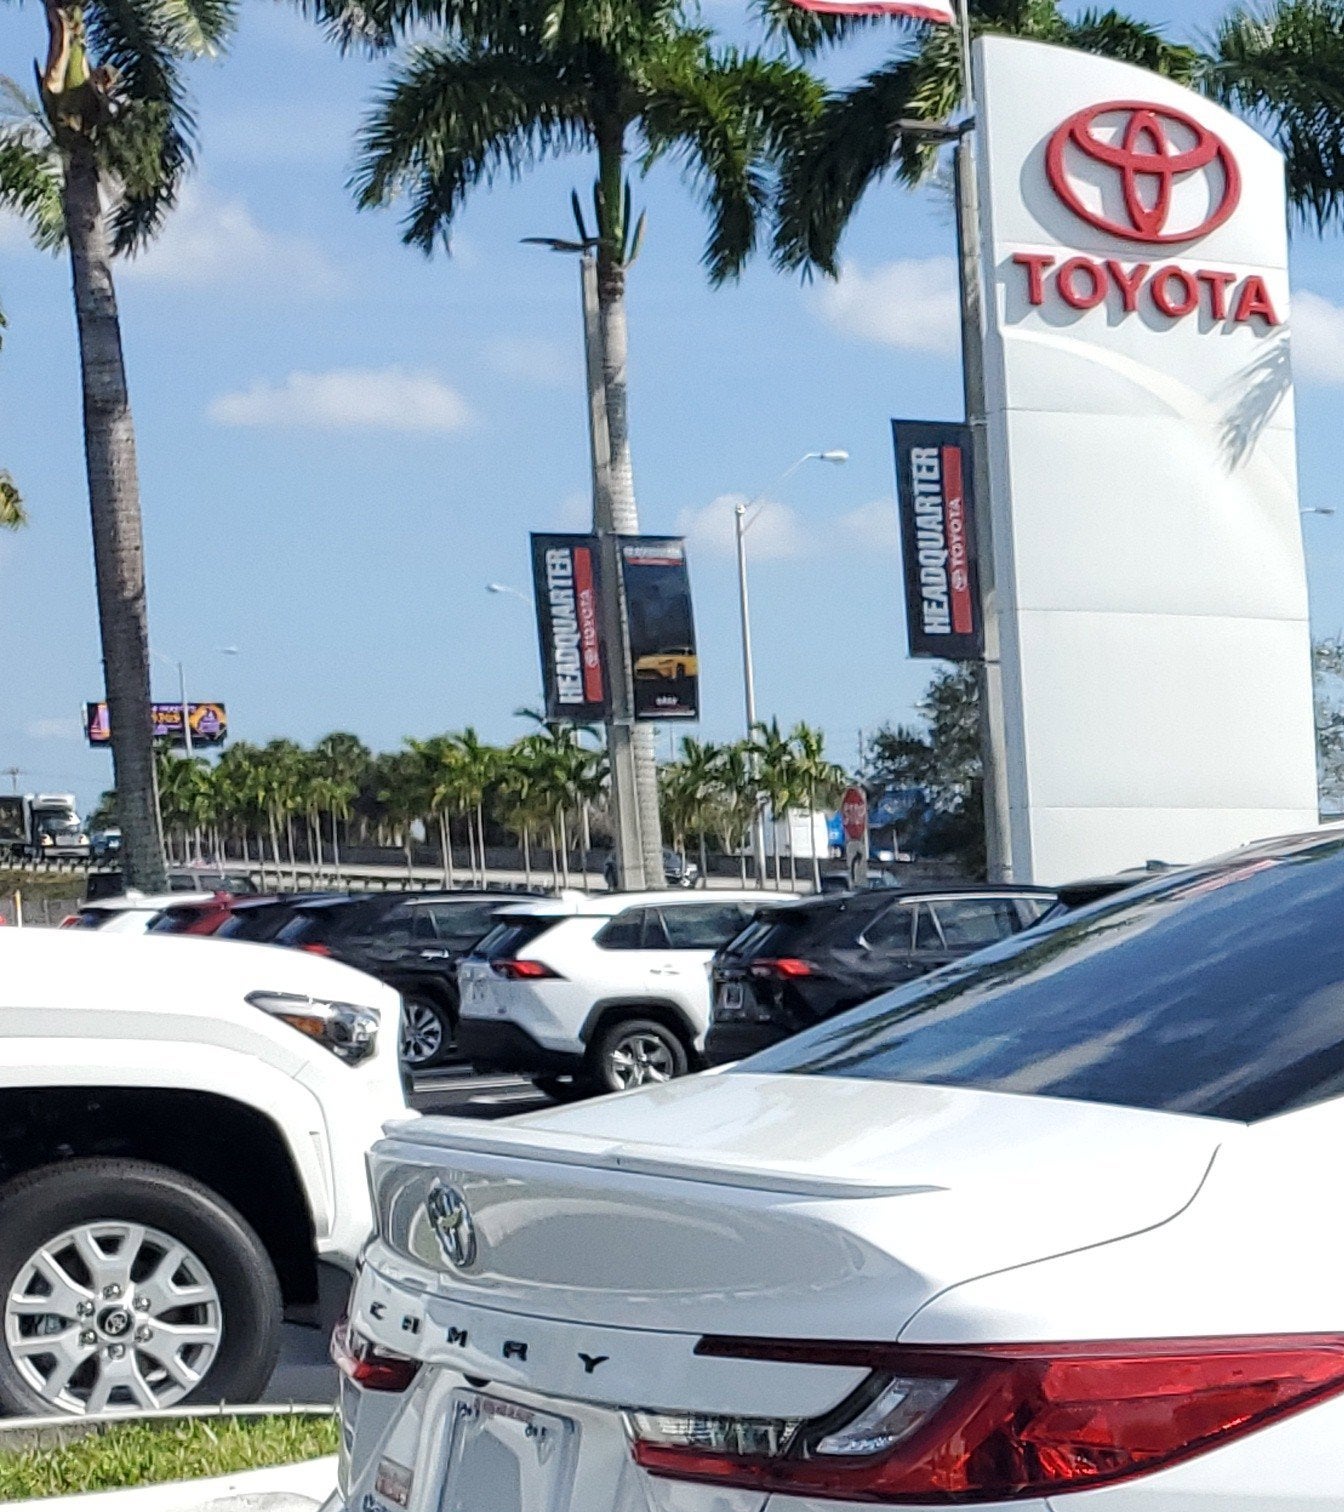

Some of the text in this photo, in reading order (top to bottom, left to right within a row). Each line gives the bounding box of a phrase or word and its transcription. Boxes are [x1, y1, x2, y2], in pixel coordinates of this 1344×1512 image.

[1013, 253, 1281, 327] TOYOTA
[911, 447, 951, 634] HEADQUARTER
[949, 498, 968, 571] TOYOTA
[546, 549, 584, 703] HEADQUARTER
[369, 1301, 610, 1374] CAMRY
